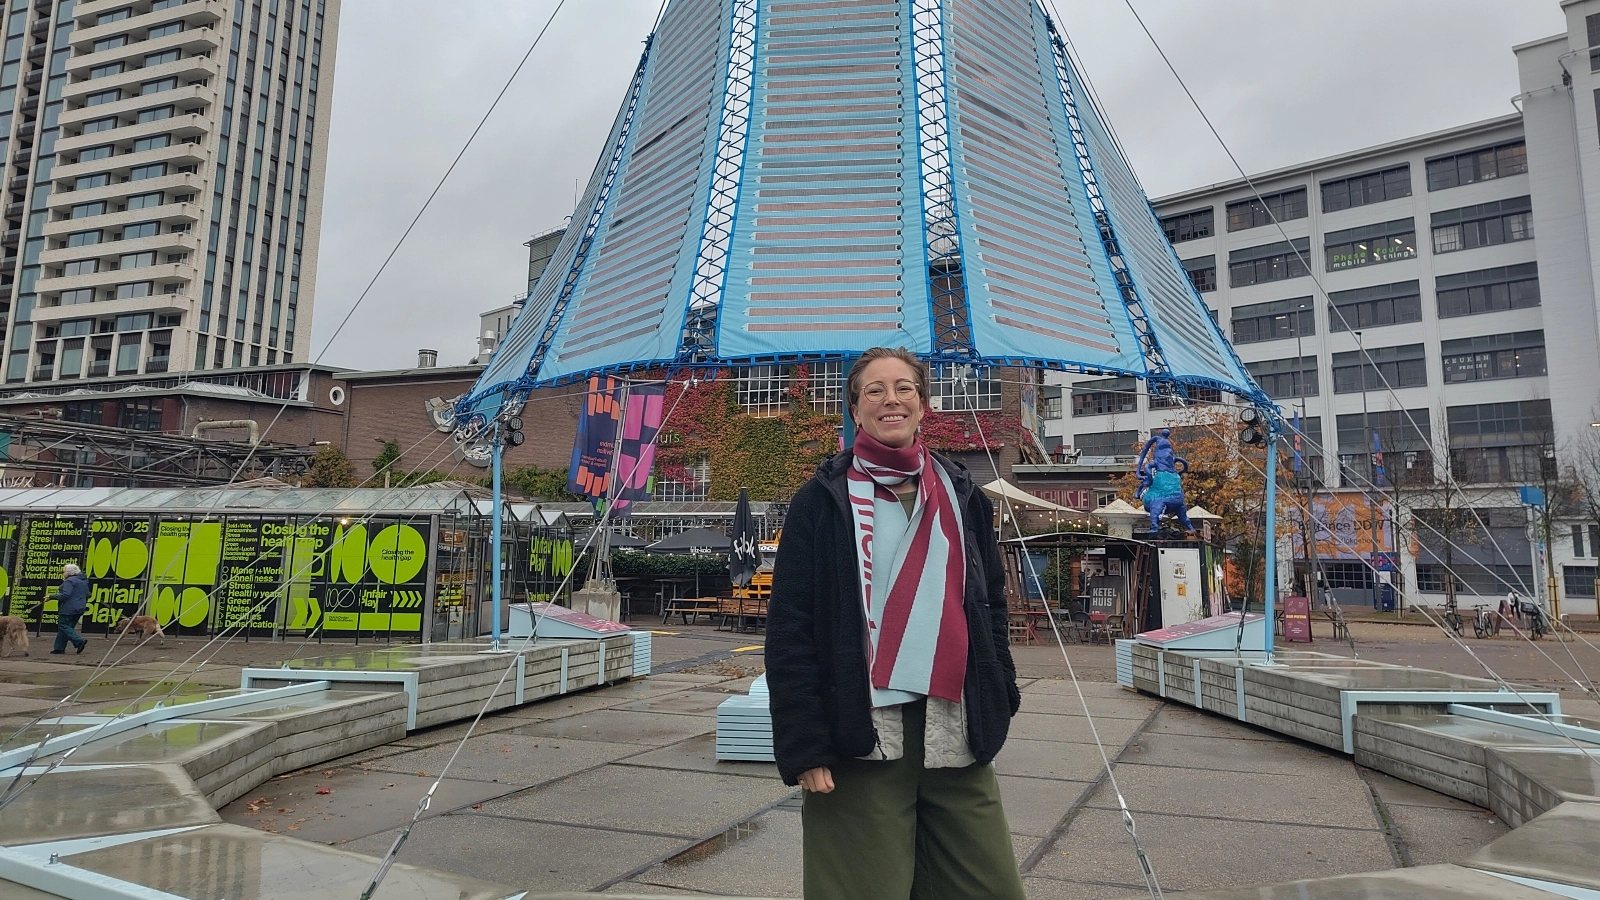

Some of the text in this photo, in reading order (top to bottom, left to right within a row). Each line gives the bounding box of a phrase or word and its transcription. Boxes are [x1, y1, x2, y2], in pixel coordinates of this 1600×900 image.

[1333, 259, 1366, 268] mobile
[133, 522, 149, 532] 25
[262, 524, 330, 537] Closing the
[62, 543, 84, 552] jaren
[529, 554, 546, 575] Play
[1092, 588, 1117, 597] KETEL
[1092, 597, 1112, 607] HUIS
